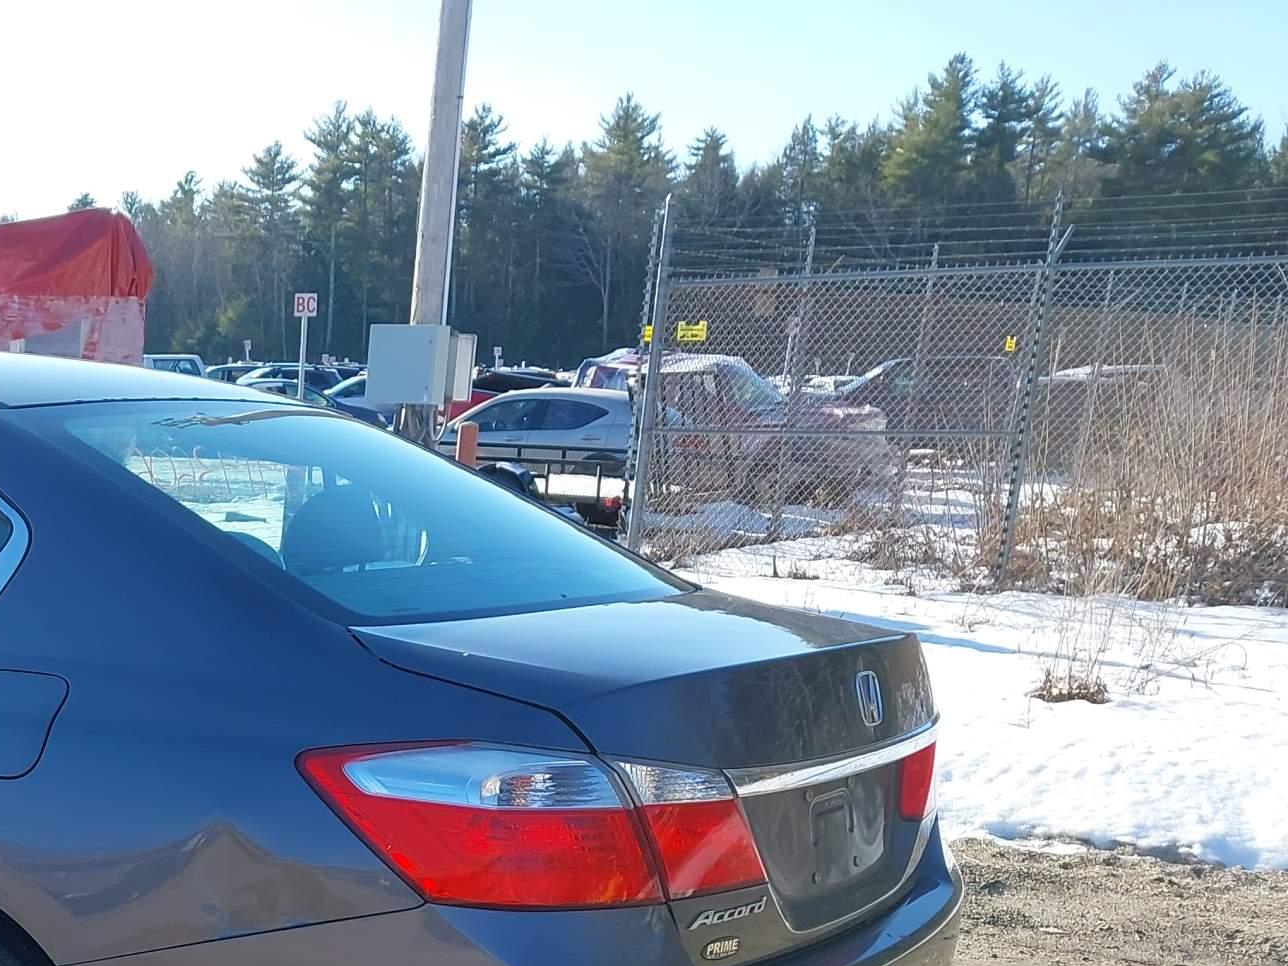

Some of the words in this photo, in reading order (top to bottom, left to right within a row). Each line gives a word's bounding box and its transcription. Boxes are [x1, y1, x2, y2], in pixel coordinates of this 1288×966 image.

[296, 296, 316, 313] BC
[688, 896, 767, 931] Accord
[706, 938, 740, 956] PRIME
